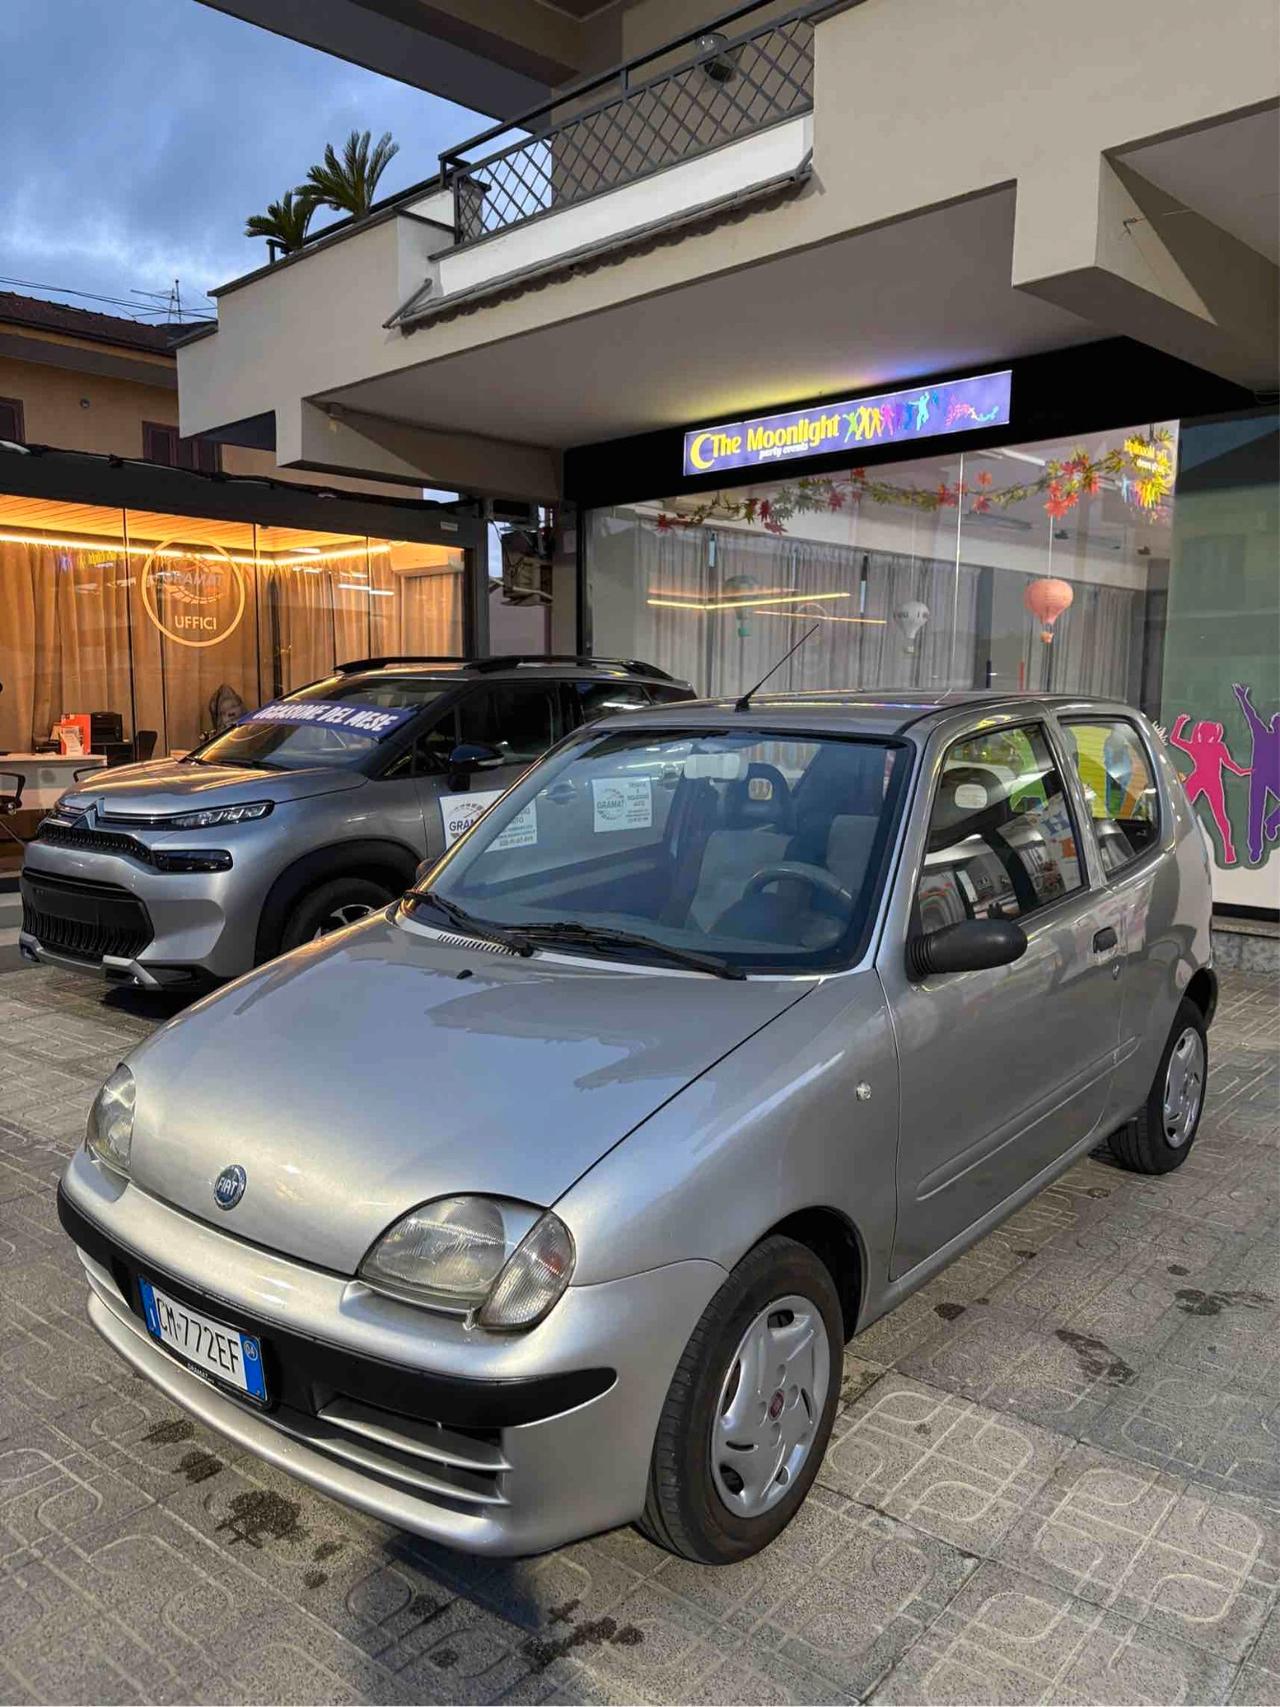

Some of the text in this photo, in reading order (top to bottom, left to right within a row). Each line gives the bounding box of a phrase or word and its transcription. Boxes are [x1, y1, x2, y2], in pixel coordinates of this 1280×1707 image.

[710, 414, 841, 458] The Moonlight
[759, 442, 810, 460] party events
[174, 615, 217, 630] UFFICI
[317, 706, 354, 723] DEL
[344, 711, 399, 732] MESE
[217, 1176, 238, 1196] FIAT
